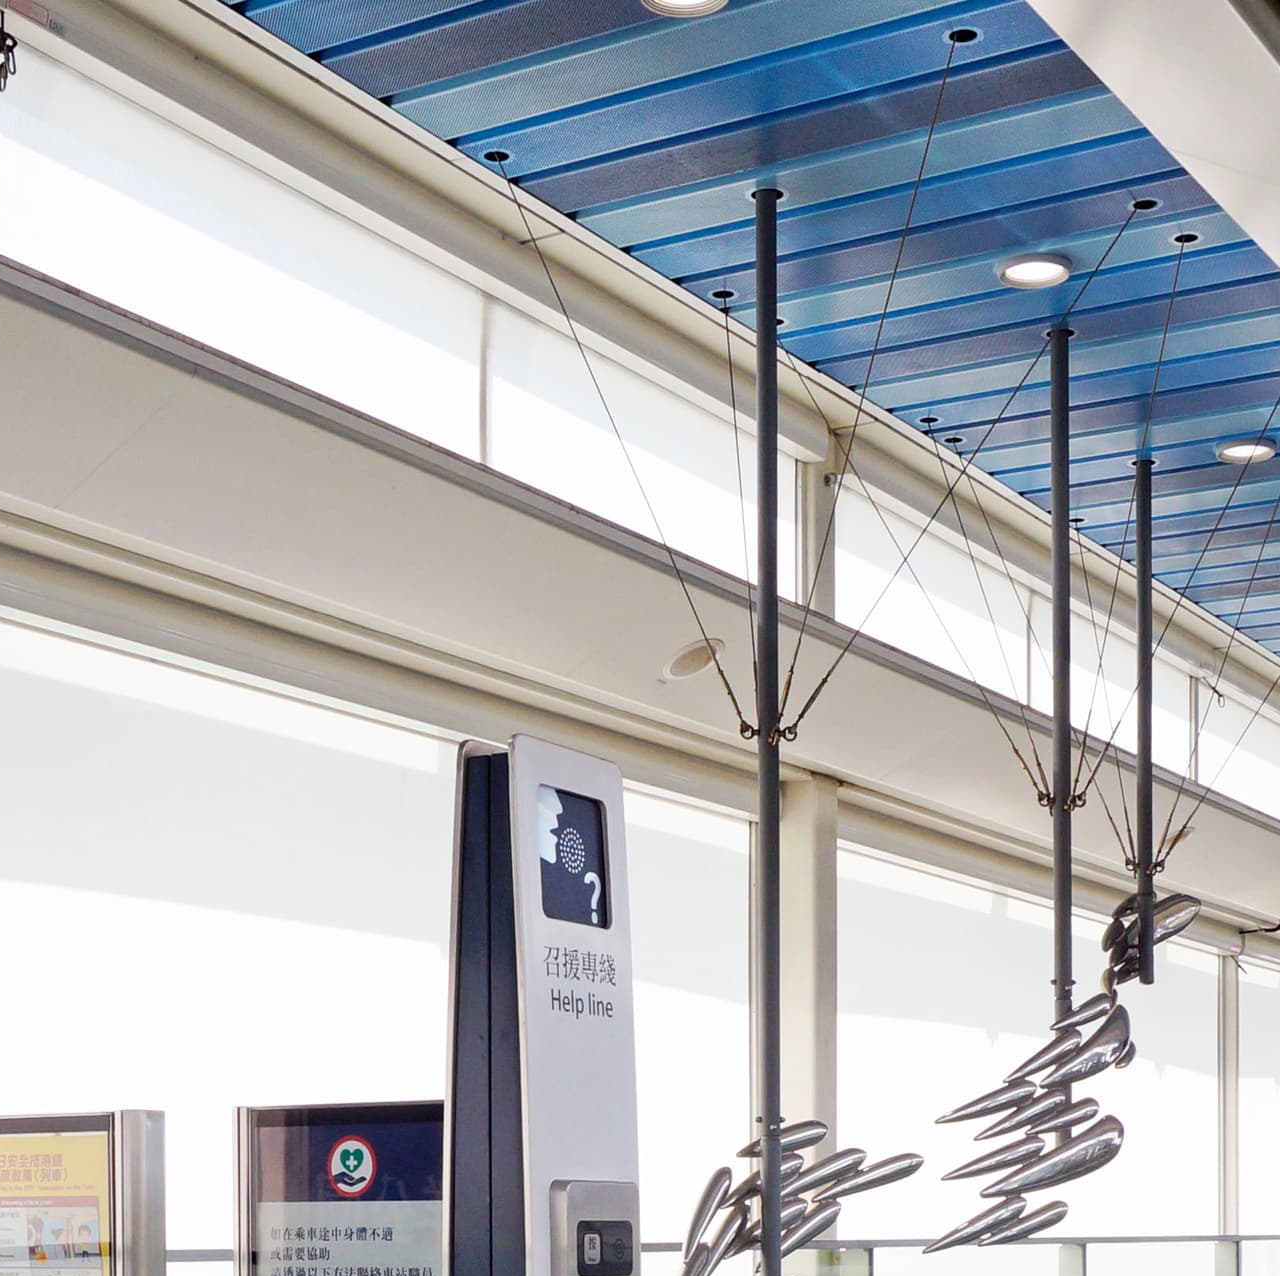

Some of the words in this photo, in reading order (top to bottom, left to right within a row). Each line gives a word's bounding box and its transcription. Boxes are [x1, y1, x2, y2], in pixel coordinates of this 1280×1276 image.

[543, 945, 617, 987] 召援專綫
[550, 987, 584, 1019] Help
[588, 991, 614, 1018] line
[271, 1247, 331, 1262] 或需要協助
